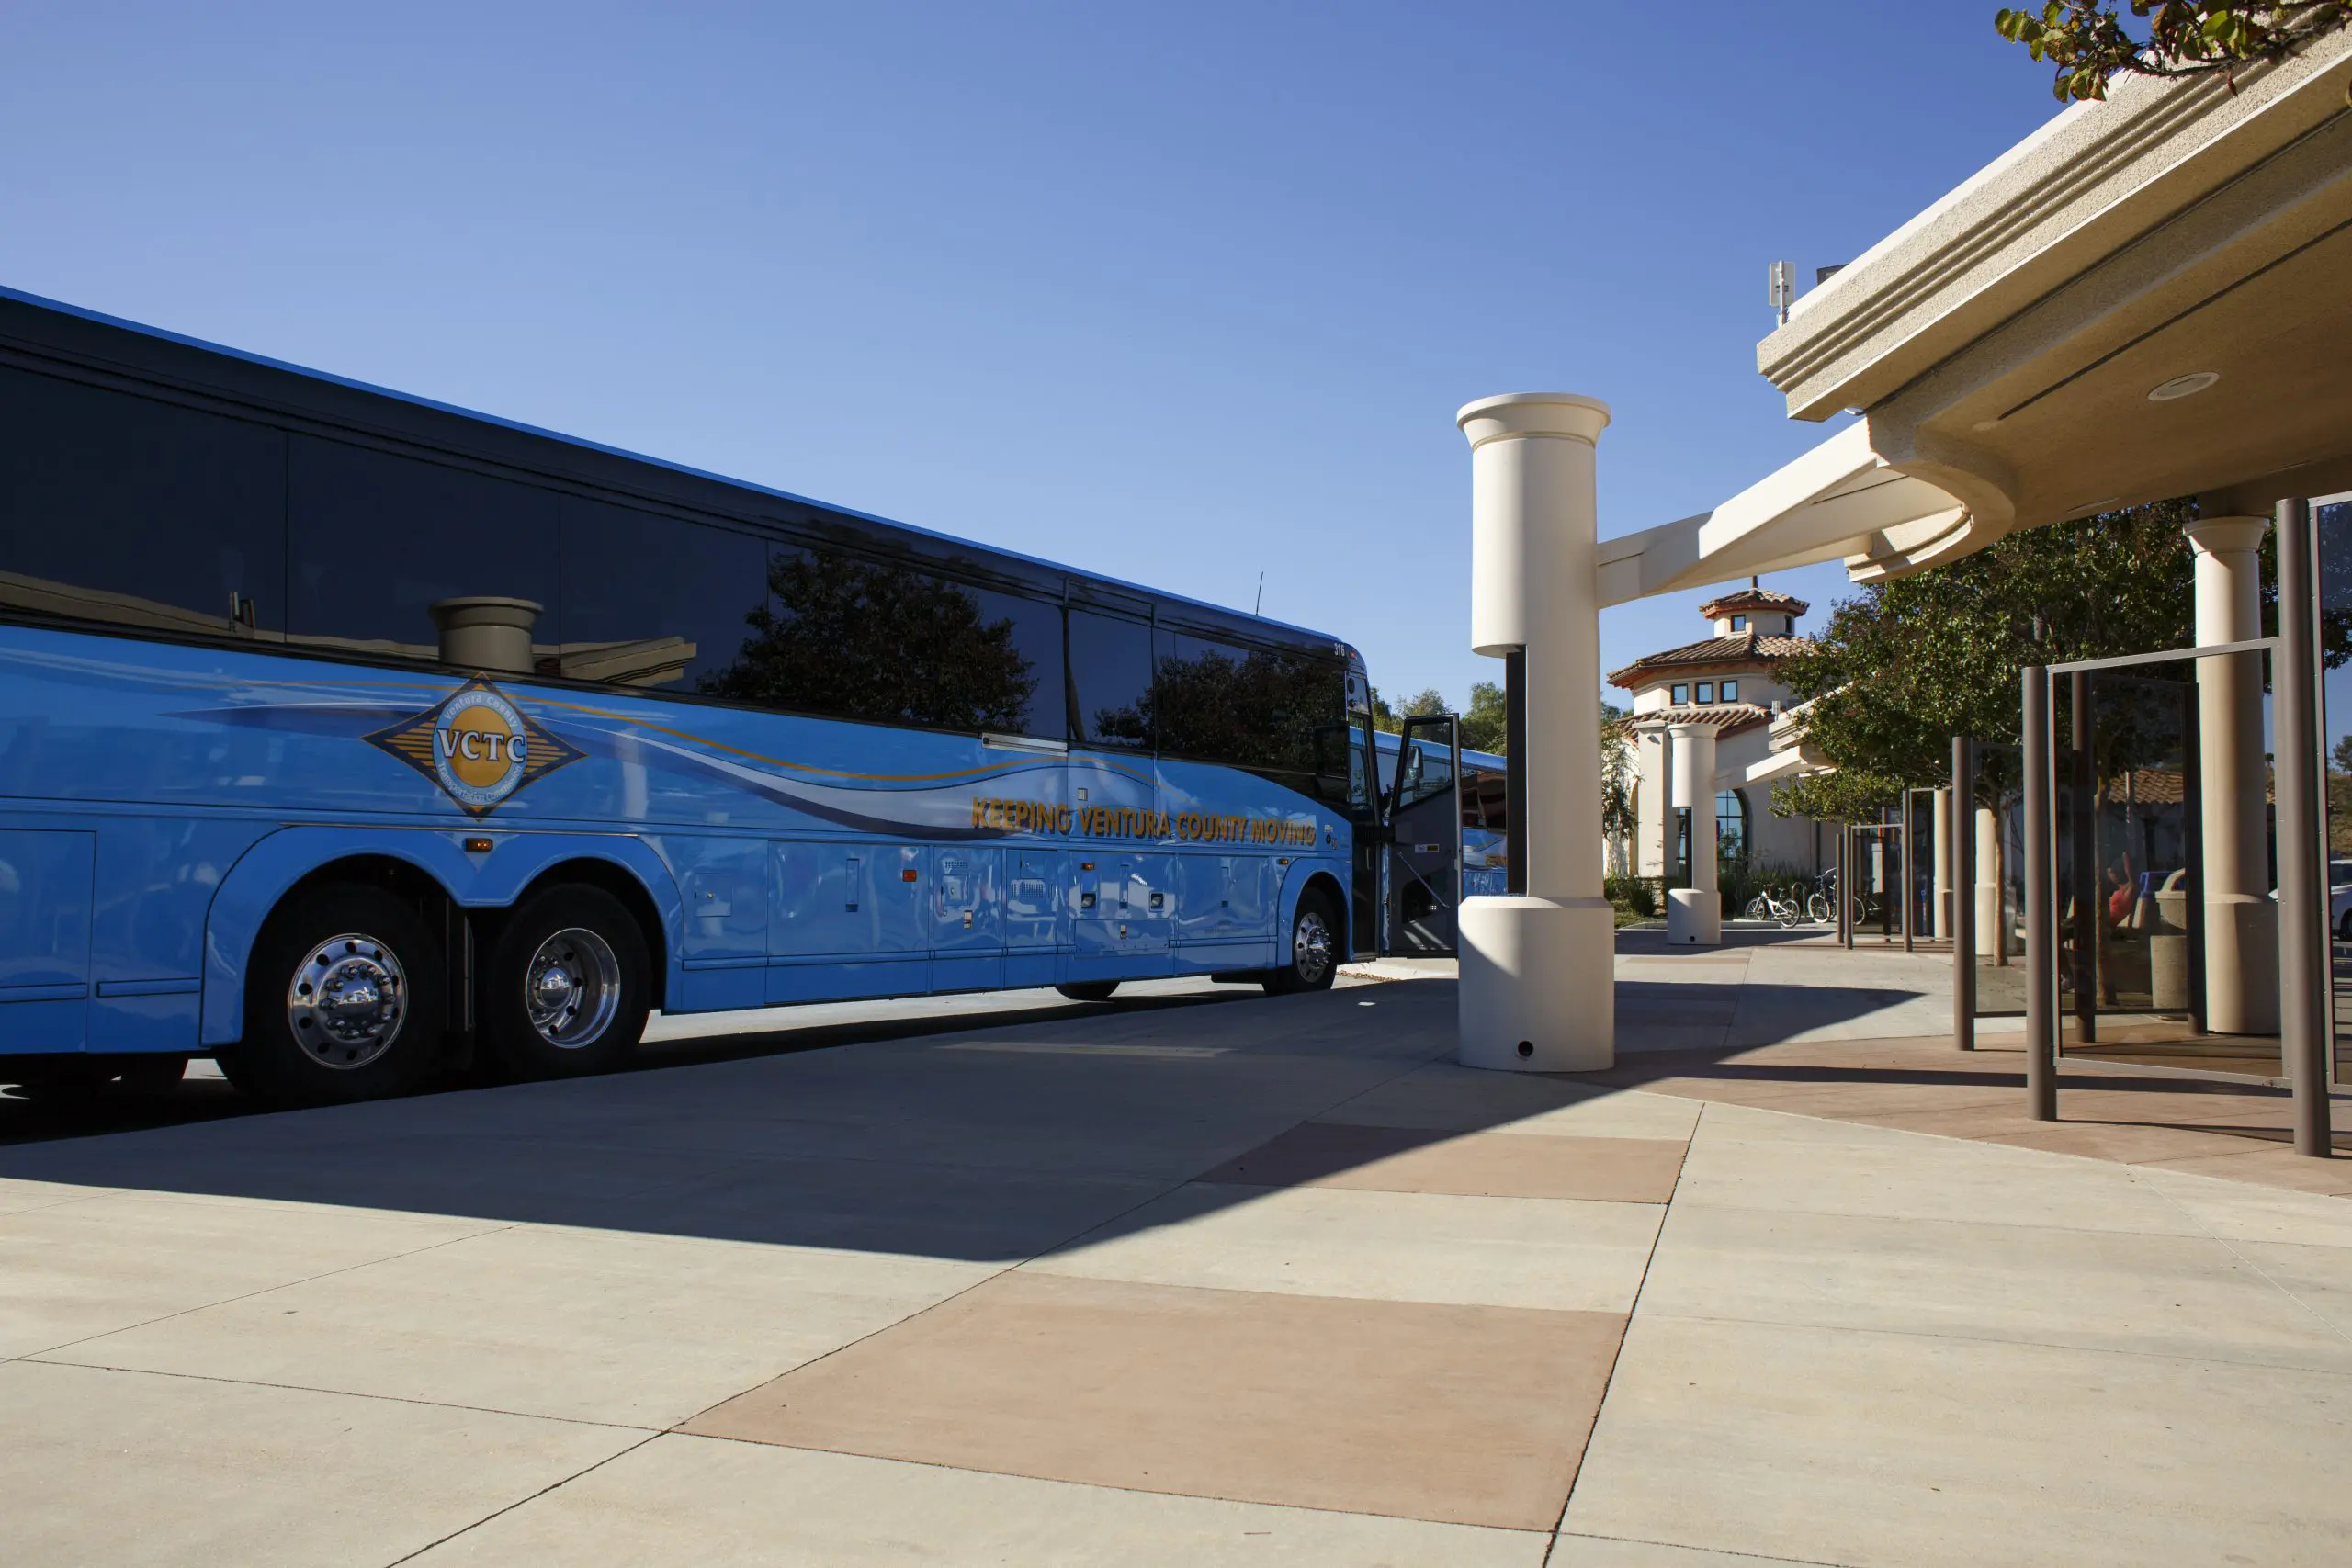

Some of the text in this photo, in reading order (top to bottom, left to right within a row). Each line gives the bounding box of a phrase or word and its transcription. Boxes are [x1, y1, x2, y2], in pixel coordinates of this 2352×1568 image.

[444, 694, 519, 728] Ventura County
[436, 728, 526, 763] VCTC
[438, 761, 523, 802] Transportation Commission
[971, 796, 1317, 846] KEEPING VENTURA COUNTY MOVING
